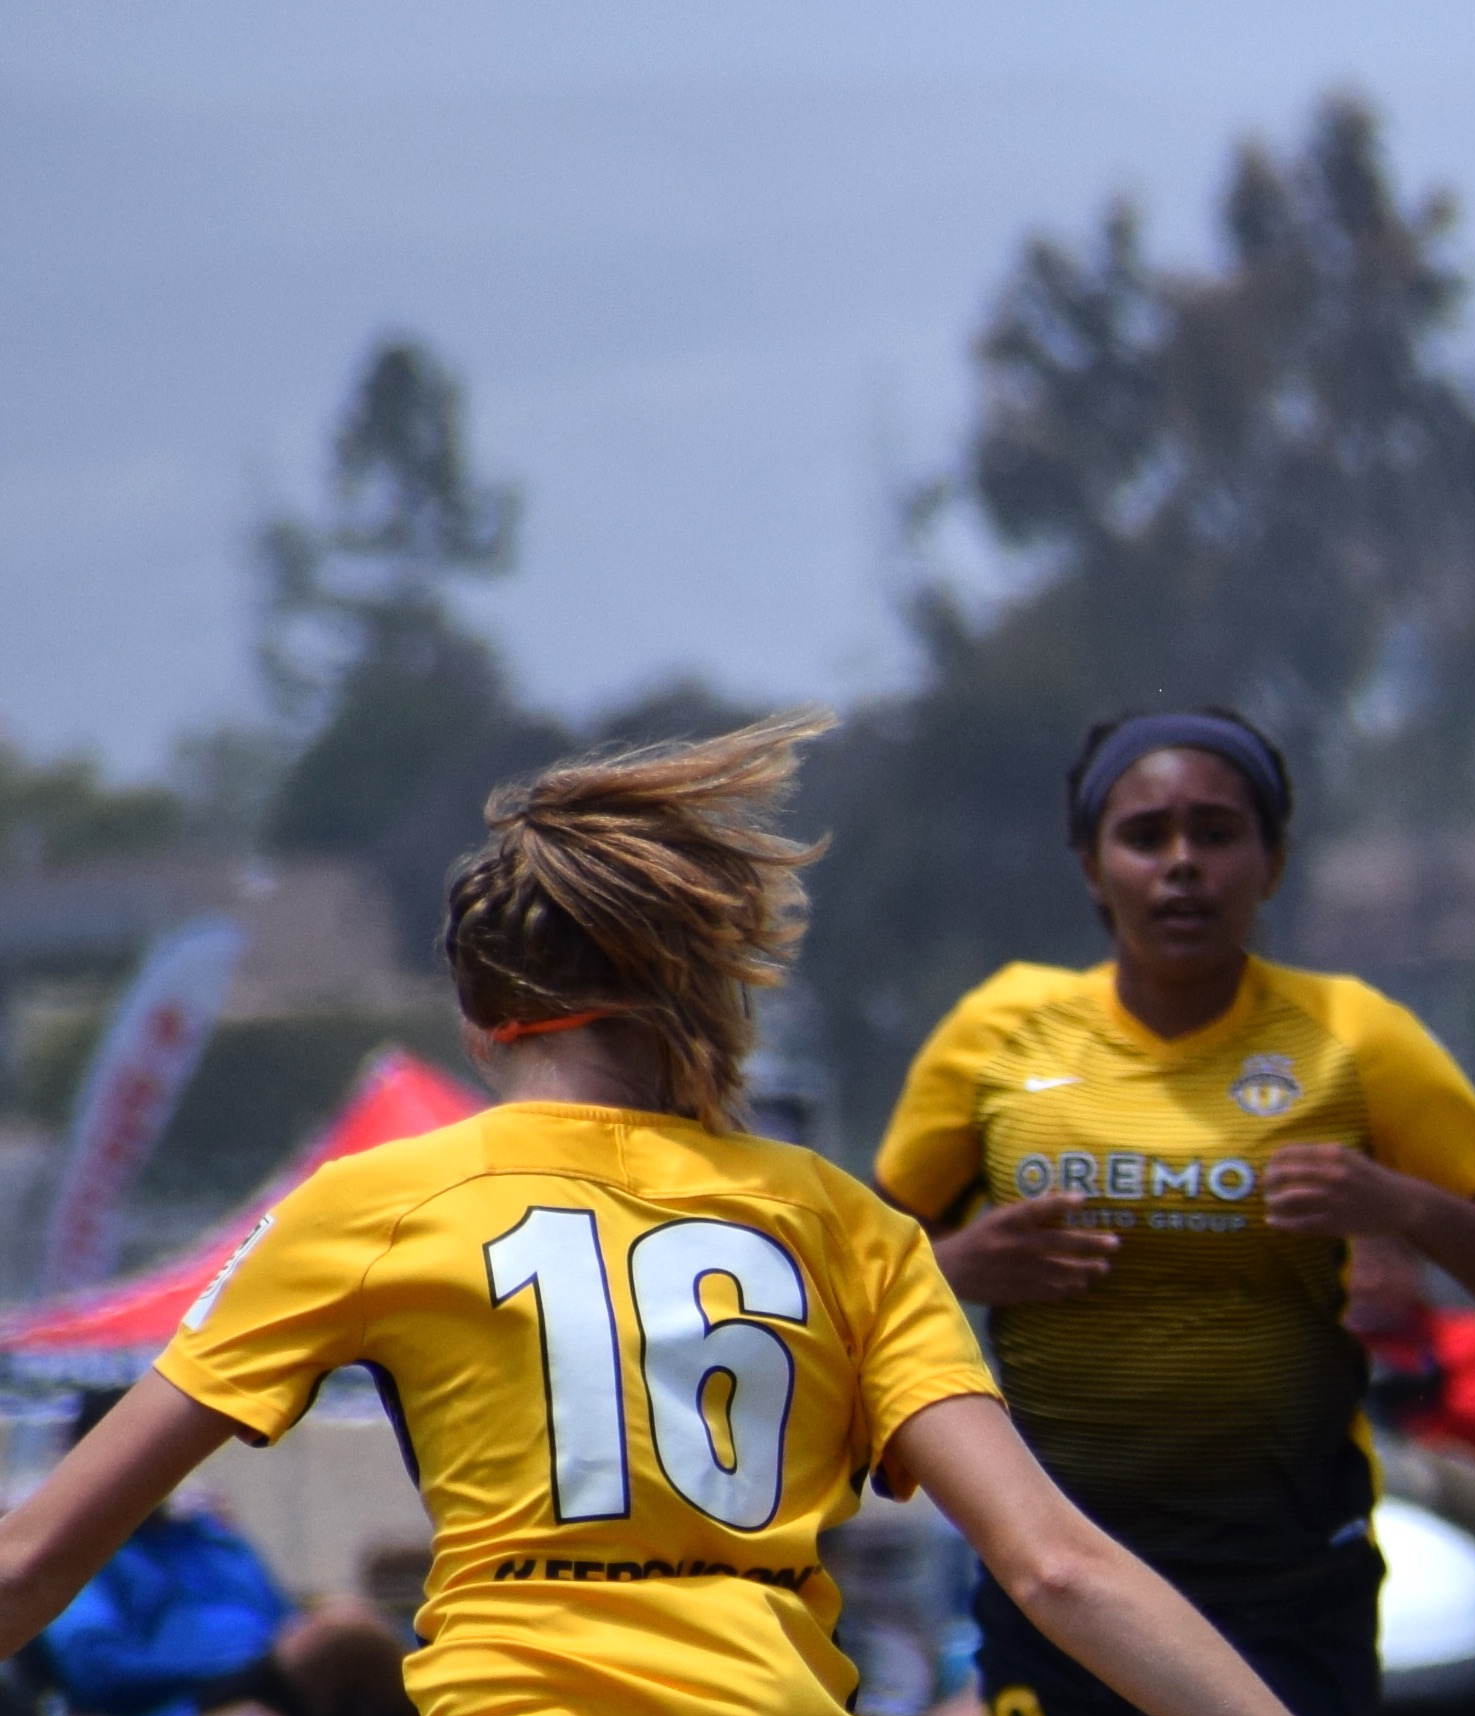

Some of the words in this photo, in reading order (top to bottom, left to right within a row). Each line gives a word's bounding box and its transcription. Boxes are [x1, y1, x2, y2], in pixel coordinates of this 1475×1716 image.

[1015, 1150, 1257, 1201] OREMO
[1150, 1210, 1248, 1232] GROUP
[483, 1205, 809, 1534] 16
